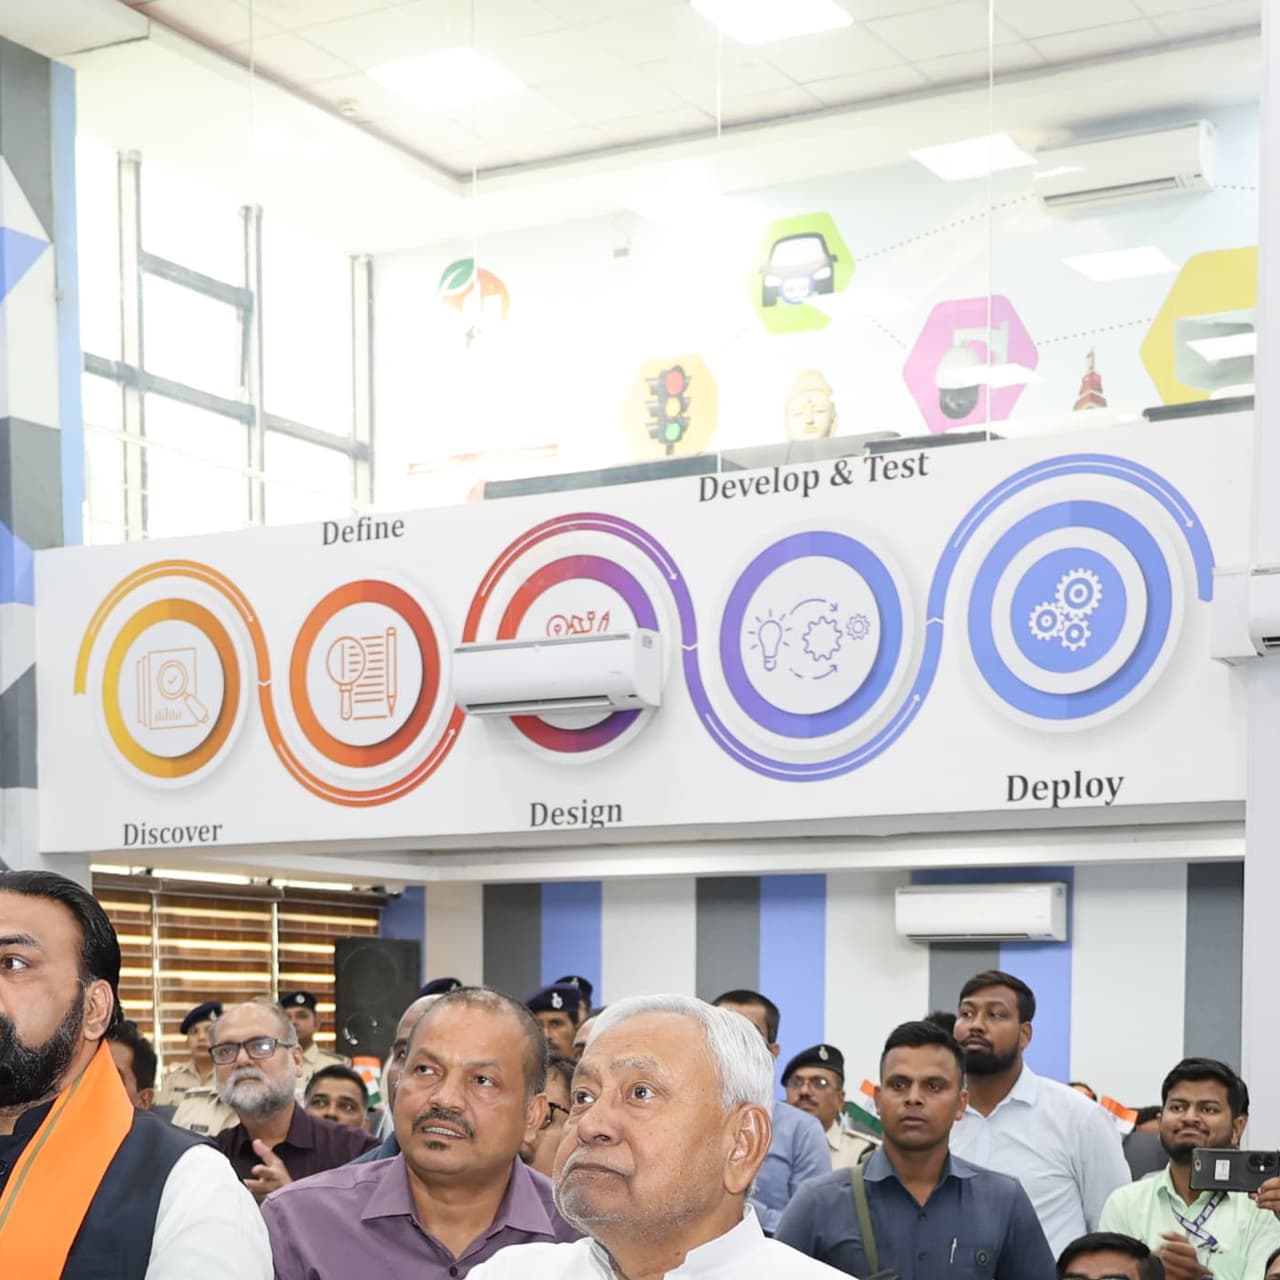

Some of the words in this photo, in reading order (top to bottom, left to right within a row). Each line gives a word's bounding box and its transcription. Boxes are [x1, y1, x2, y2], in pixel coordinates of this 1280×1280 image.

[698, 467, 820, 503] Develop
[830, 461, 853, 487] &
[863, 451, 929, 483] Test
[322, 516, 405, 546] Define
[1007, 770, 1124, 808] Deploy
[530, 799, 623, 829] Design
[123, 821, 223, 846] Discover
